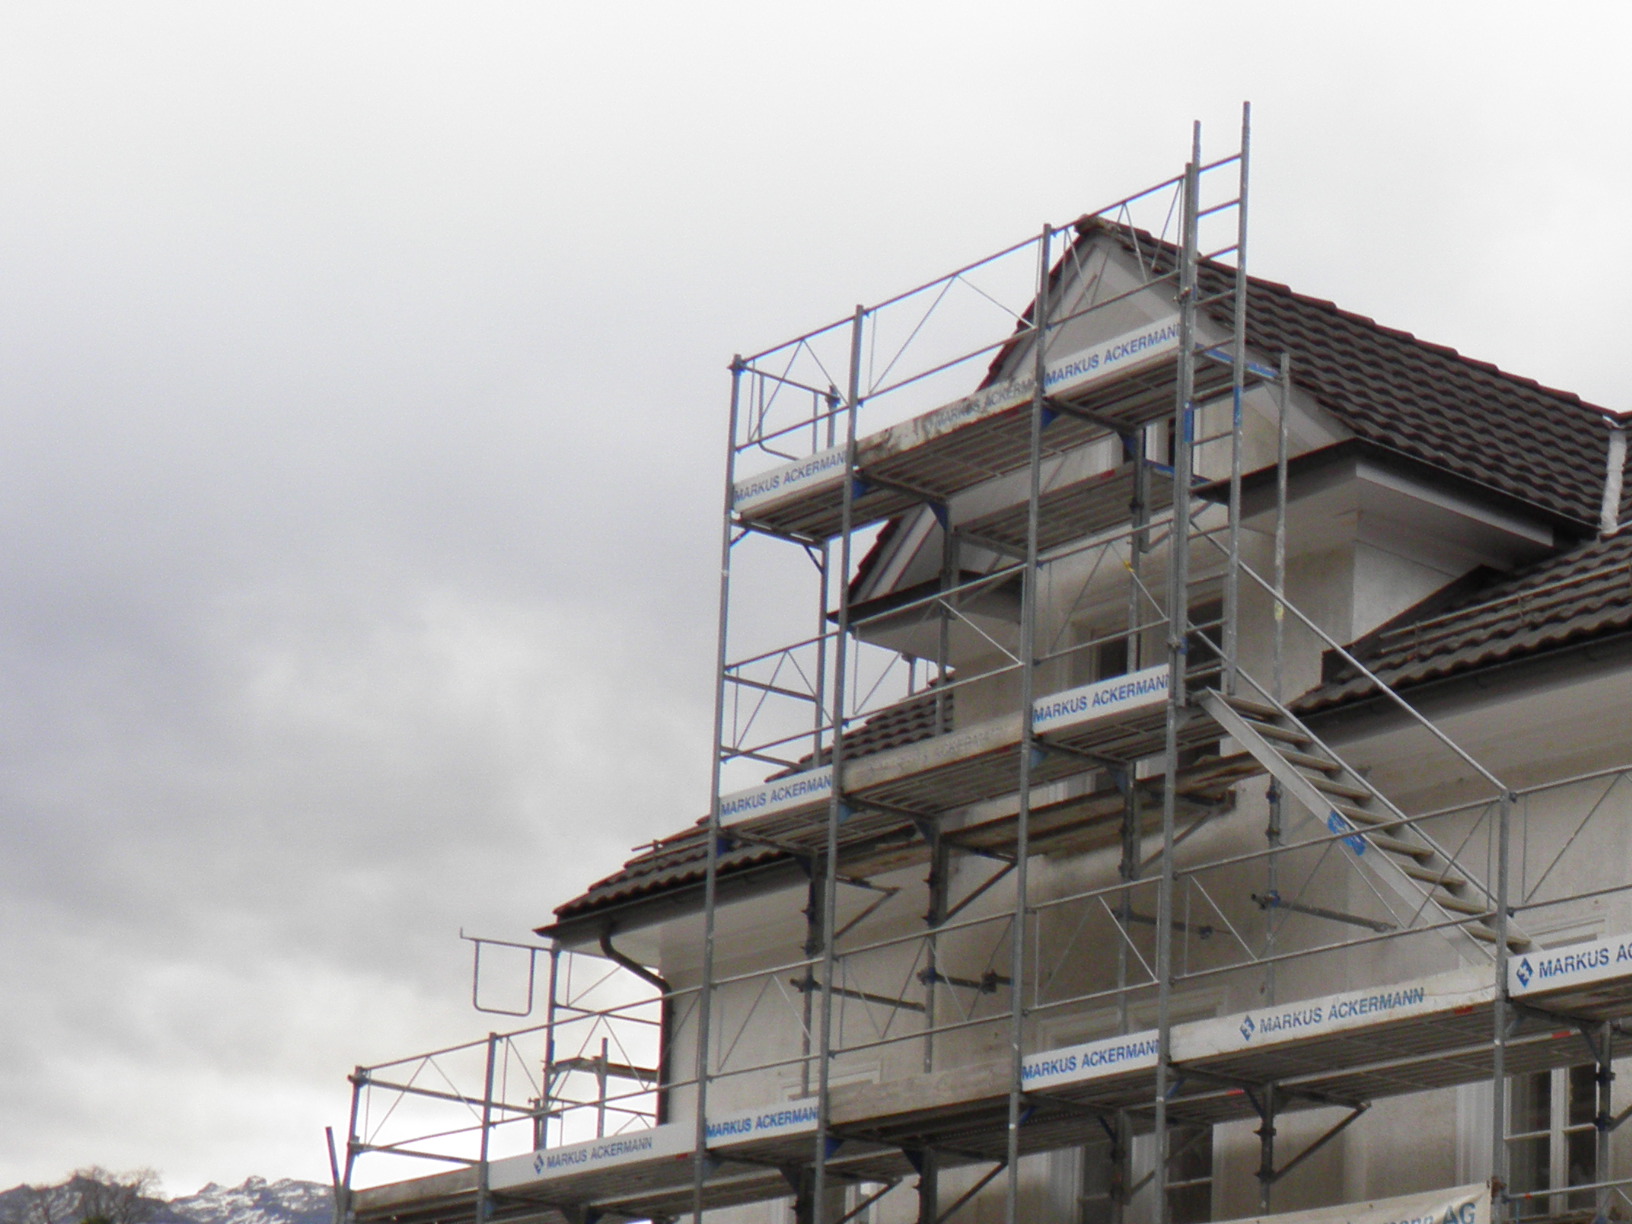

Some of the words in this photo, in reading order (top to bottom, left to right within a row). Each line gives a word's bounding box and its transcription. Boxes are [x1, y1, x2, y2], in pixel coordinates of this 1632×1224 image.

[1045, 353, 1100, 387] MARKUS
[733, 473, 780, 501] MARKUS
[1033, 695, 1088, 724] MARKUS
[720, 791, 767, 817] MARKUS
[1539, 949, 1609, 979] MARKUS
[1259, 1008, 1322, 1035] MARKUS
[1327, 986, 1425, 1020] ACKERMANN
[1022, 1055, 1077, 1082] MARKUS
[706, 1118, 751, 1138] MARKUS
[546, 1148, 587, 1170] MARKUS
[590, 1136, 652, 1160] ACKERMANN
